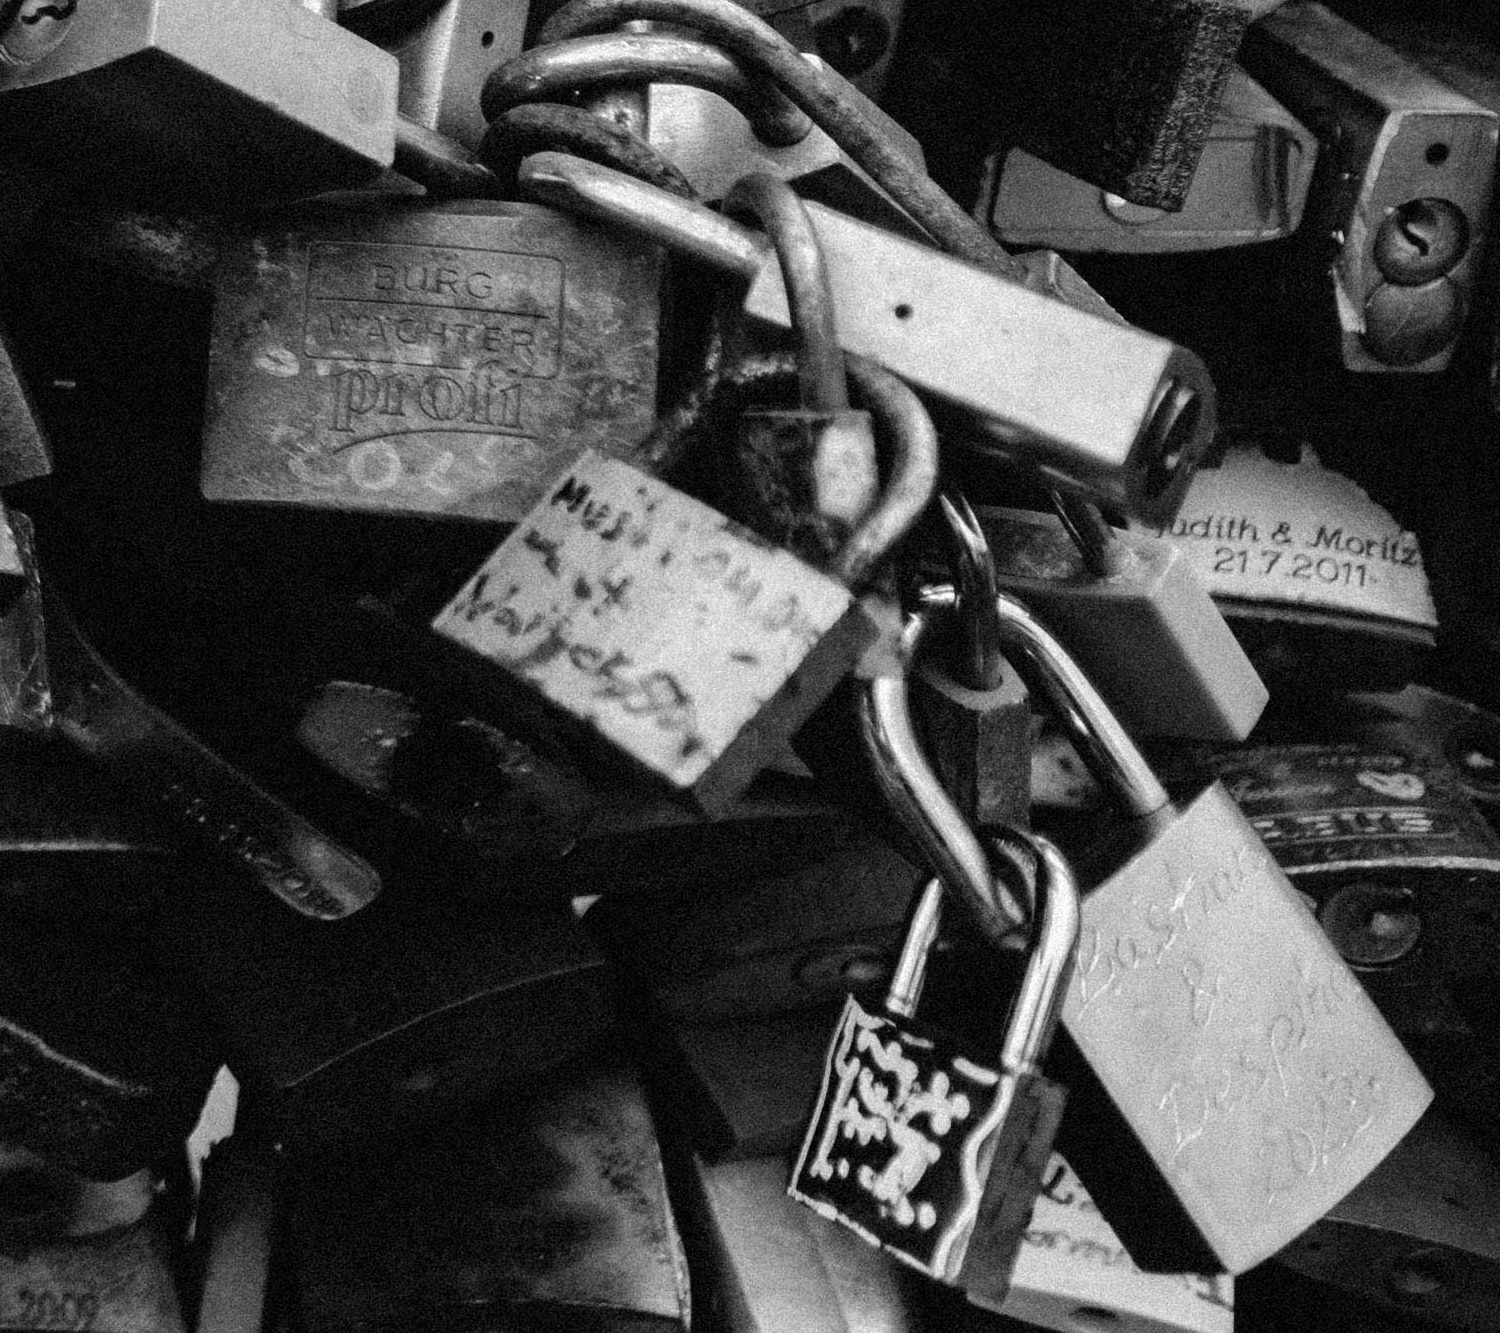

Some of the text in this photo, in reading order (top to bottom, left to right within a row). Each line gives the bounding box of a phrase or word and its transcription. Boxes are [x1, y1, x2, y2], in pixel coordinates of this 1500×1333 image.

[374, 264, 494, 300] BURG
[331, 360, 524, 435] profi
[1271, 523, 1293, 545] &
[1310, 525, 1420, 569] Moritz
